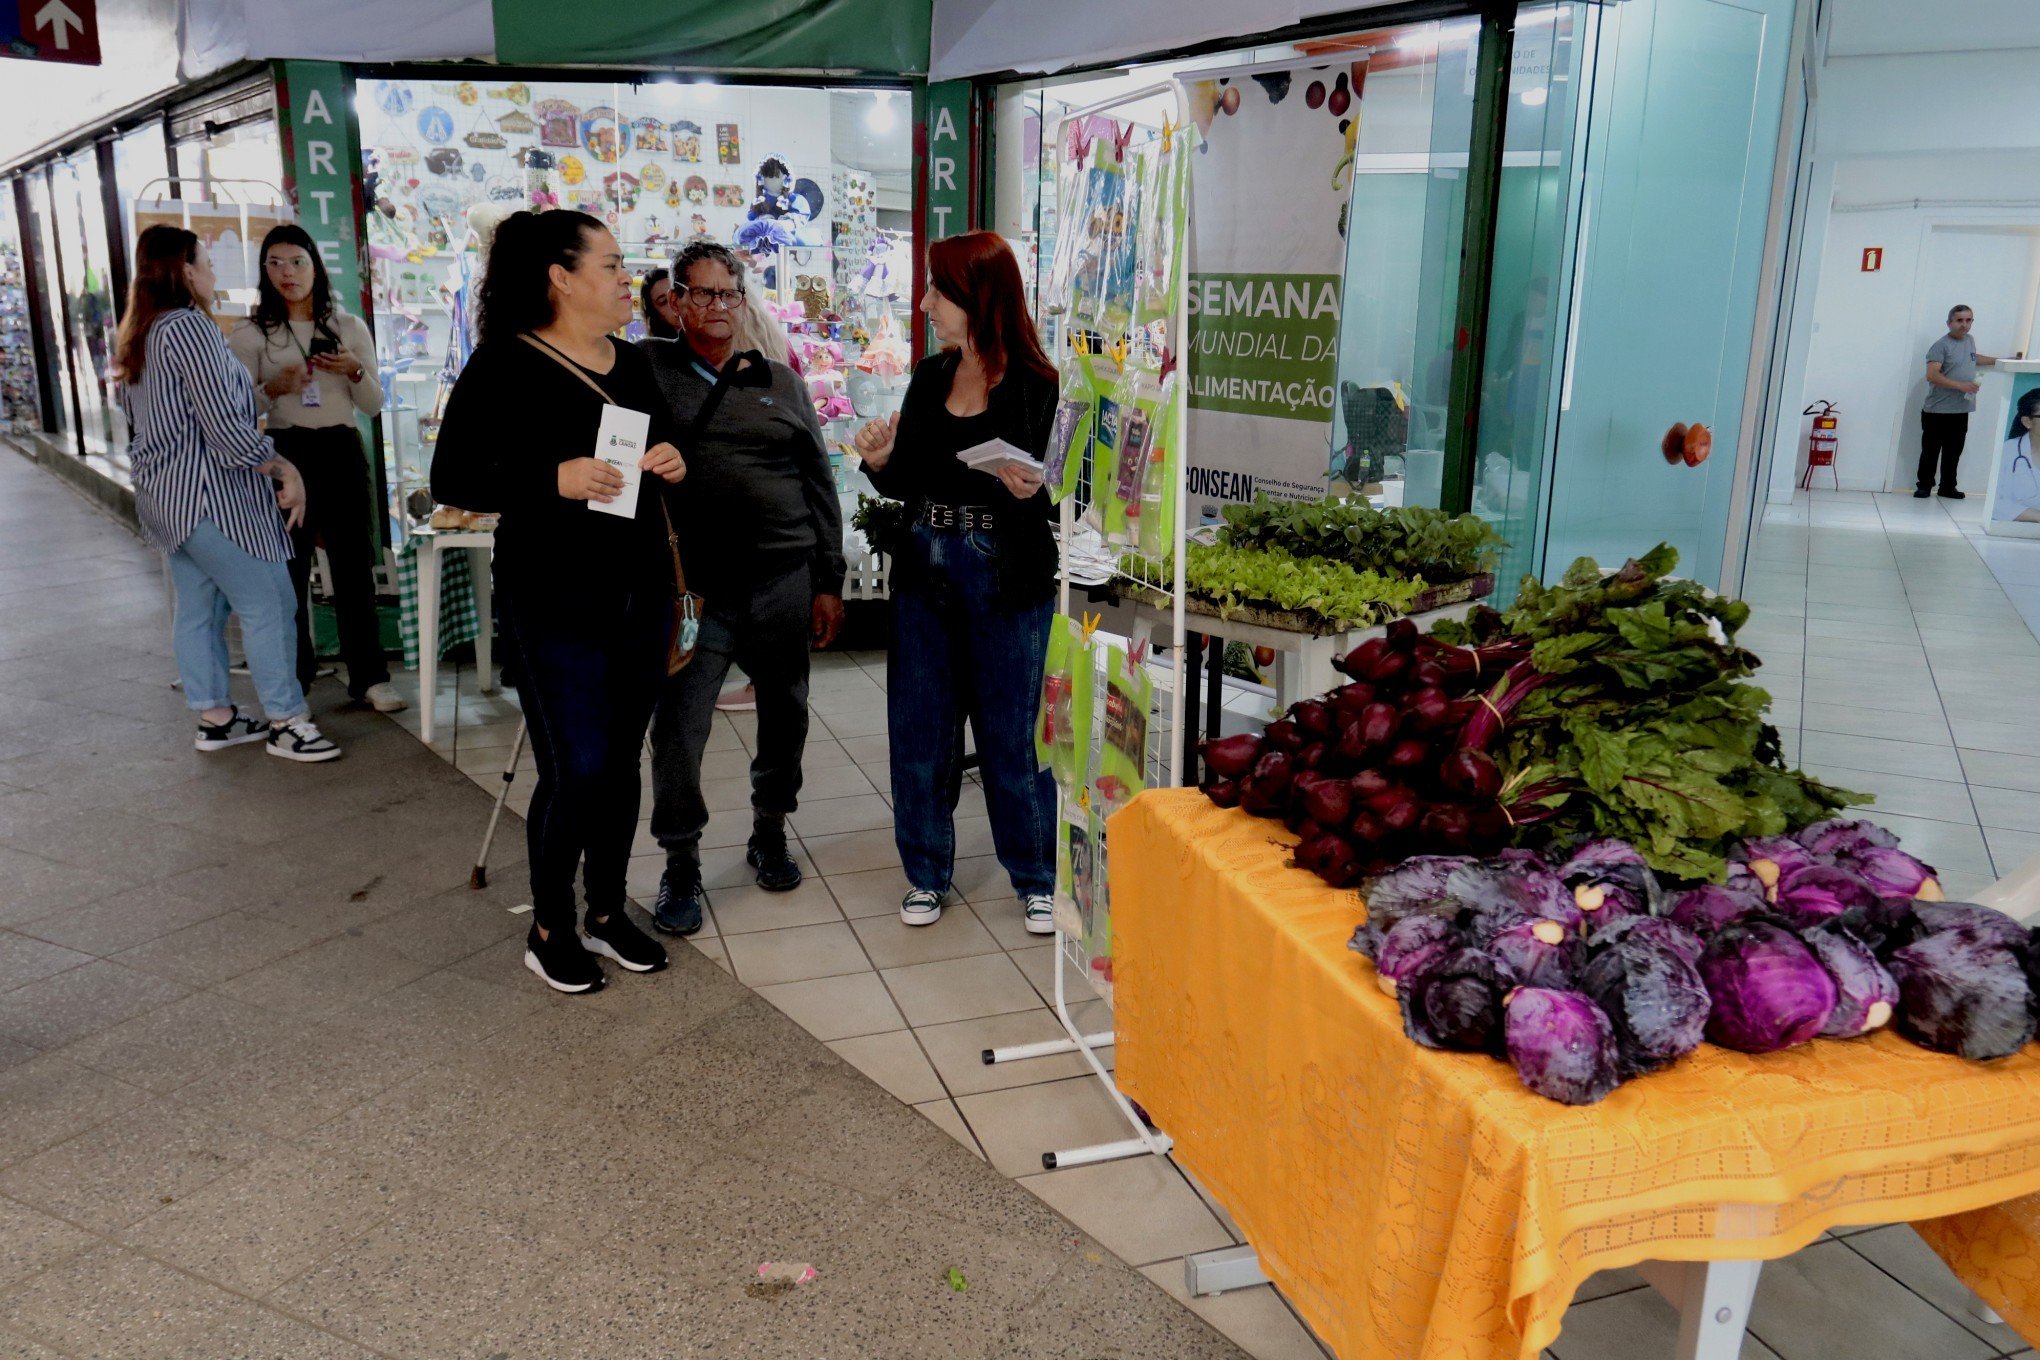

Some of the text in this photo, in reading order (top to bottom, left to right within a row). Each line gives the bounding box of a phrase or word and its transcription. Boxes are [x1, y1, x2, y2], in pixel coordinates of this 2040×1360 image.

[1188, 279, 1341, 321] SEMANA
[1301, 335, 1338, 363] DA
[1187, 466, 1253, 503] ONSEAN
[1254, 476, 1325, 493] Conselho de Segurança
